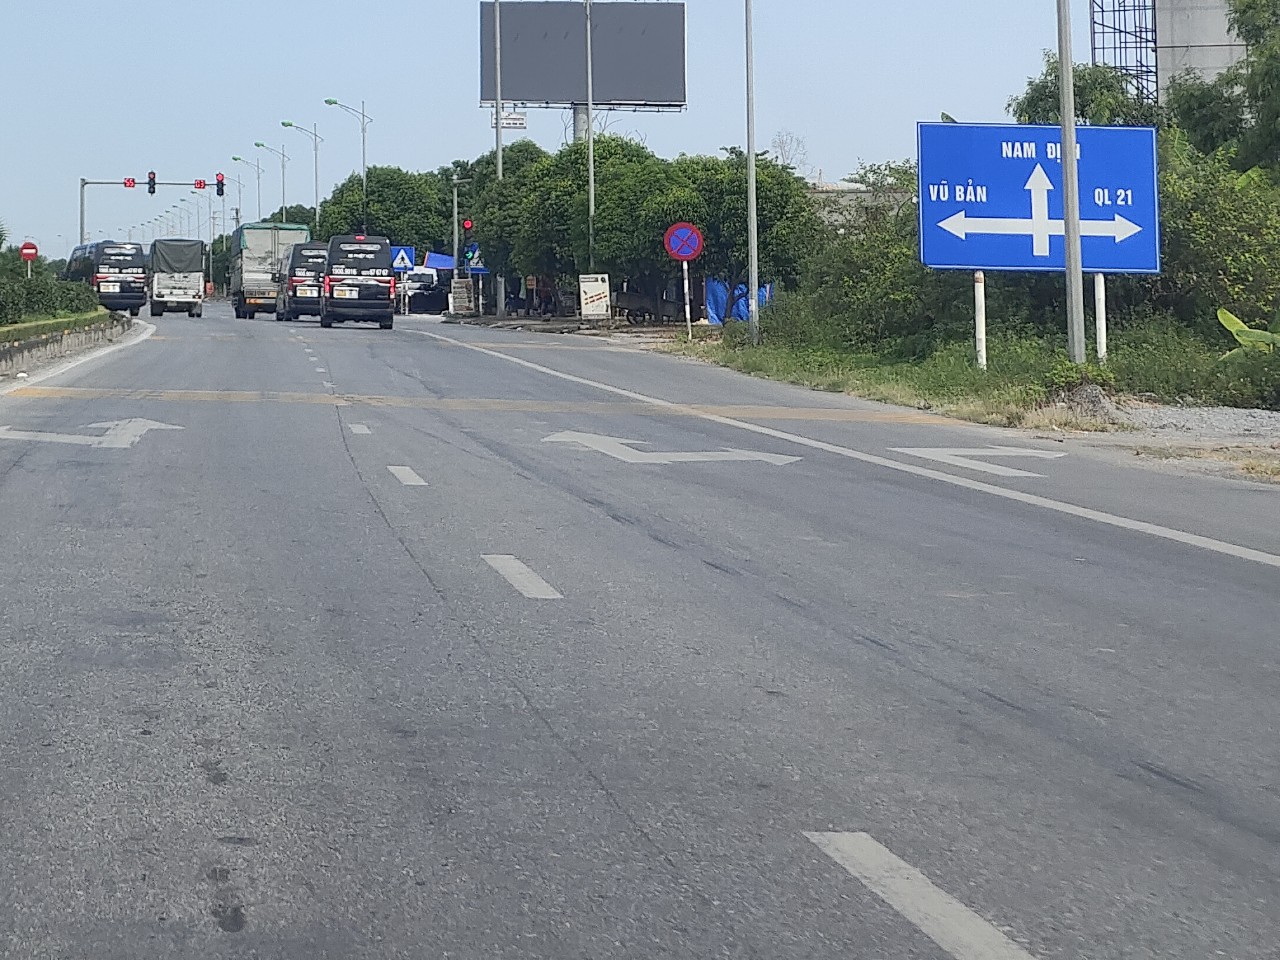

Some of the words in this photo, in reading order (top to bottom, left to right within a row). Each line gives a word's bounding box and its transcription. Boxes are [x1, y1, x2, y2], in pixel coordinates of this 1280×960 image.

[1001, 141, 1036, 159] NAM
[1046, 142, 1081, 162] ĐỊ
[929, 181, 949, 202] VŨ
[955, 179, 987, 203] BẢN
[1094, 188, 1112, 207] QL
[1116, 189, 1133, 206] 21
